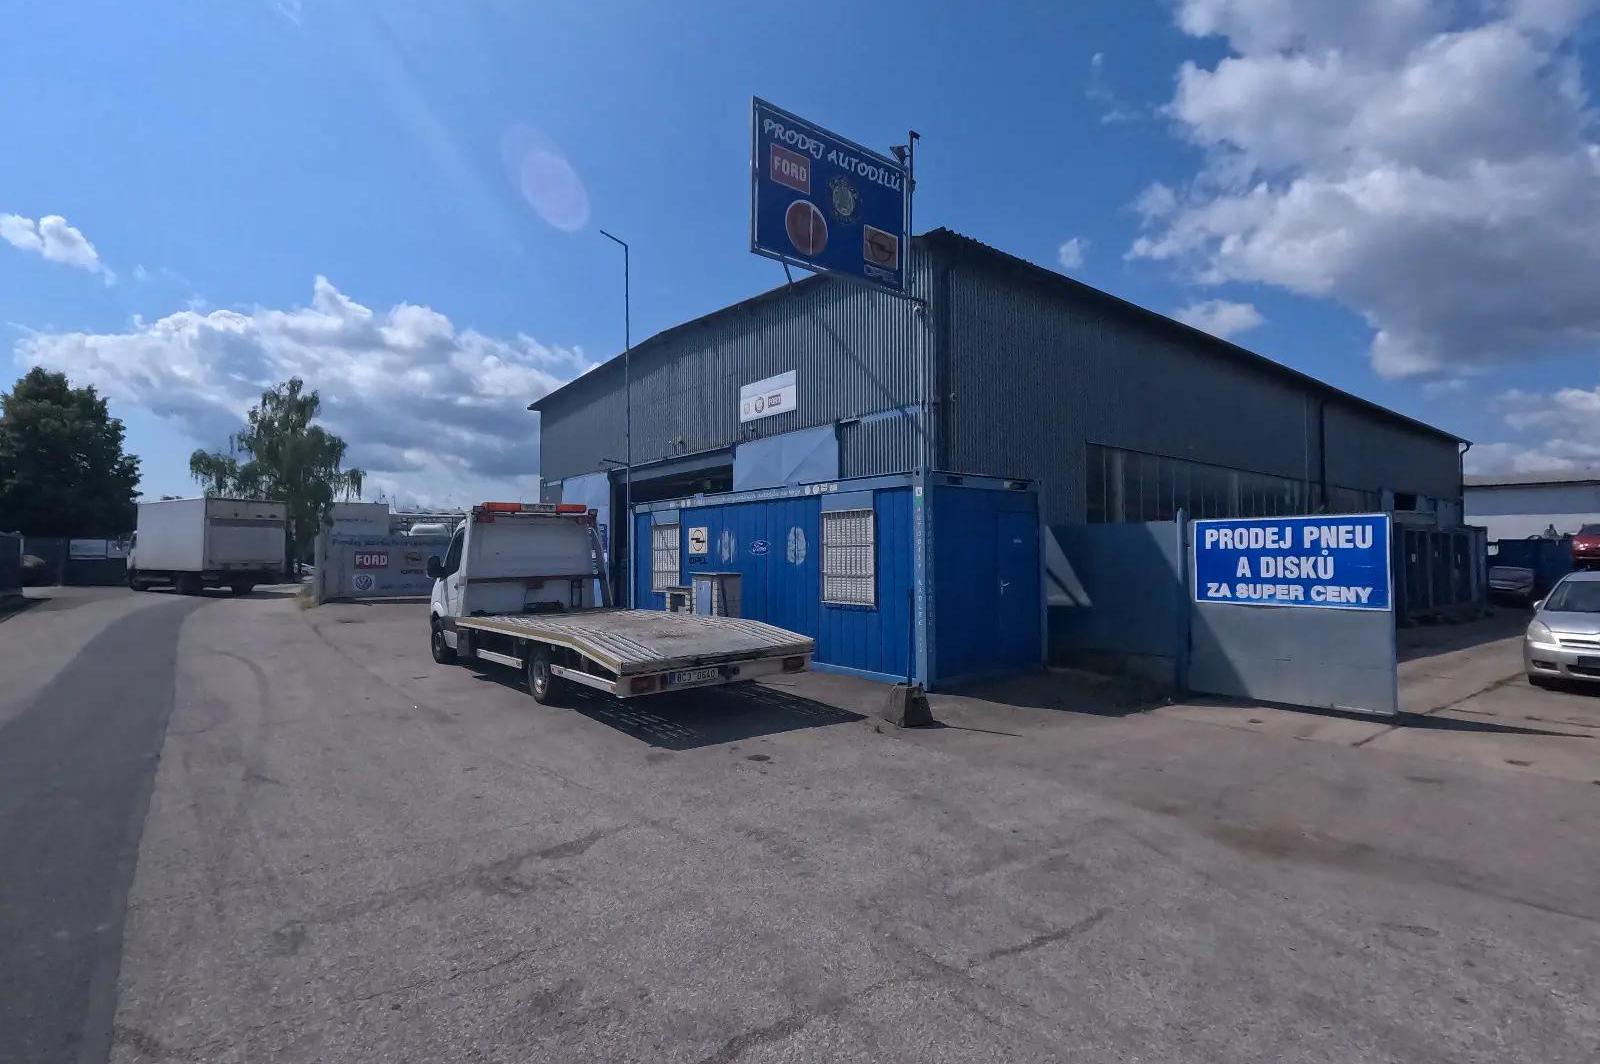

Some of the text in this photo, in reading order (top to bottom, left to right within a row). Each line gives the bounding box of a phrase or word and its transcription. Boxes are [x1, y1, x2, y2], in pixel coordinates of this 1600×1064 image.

[763, 118, 826, 160] PRODEJ
[773, 156, 807, 182] FORD
[1204, 525, 1373, 550] PRODEJ PNEU
[355, 554, 388, 567] FORD
[1236, 549, 1335, 580] A DISKŮ
[1207, 582, 1374, 604] ZA SUPER CENY
